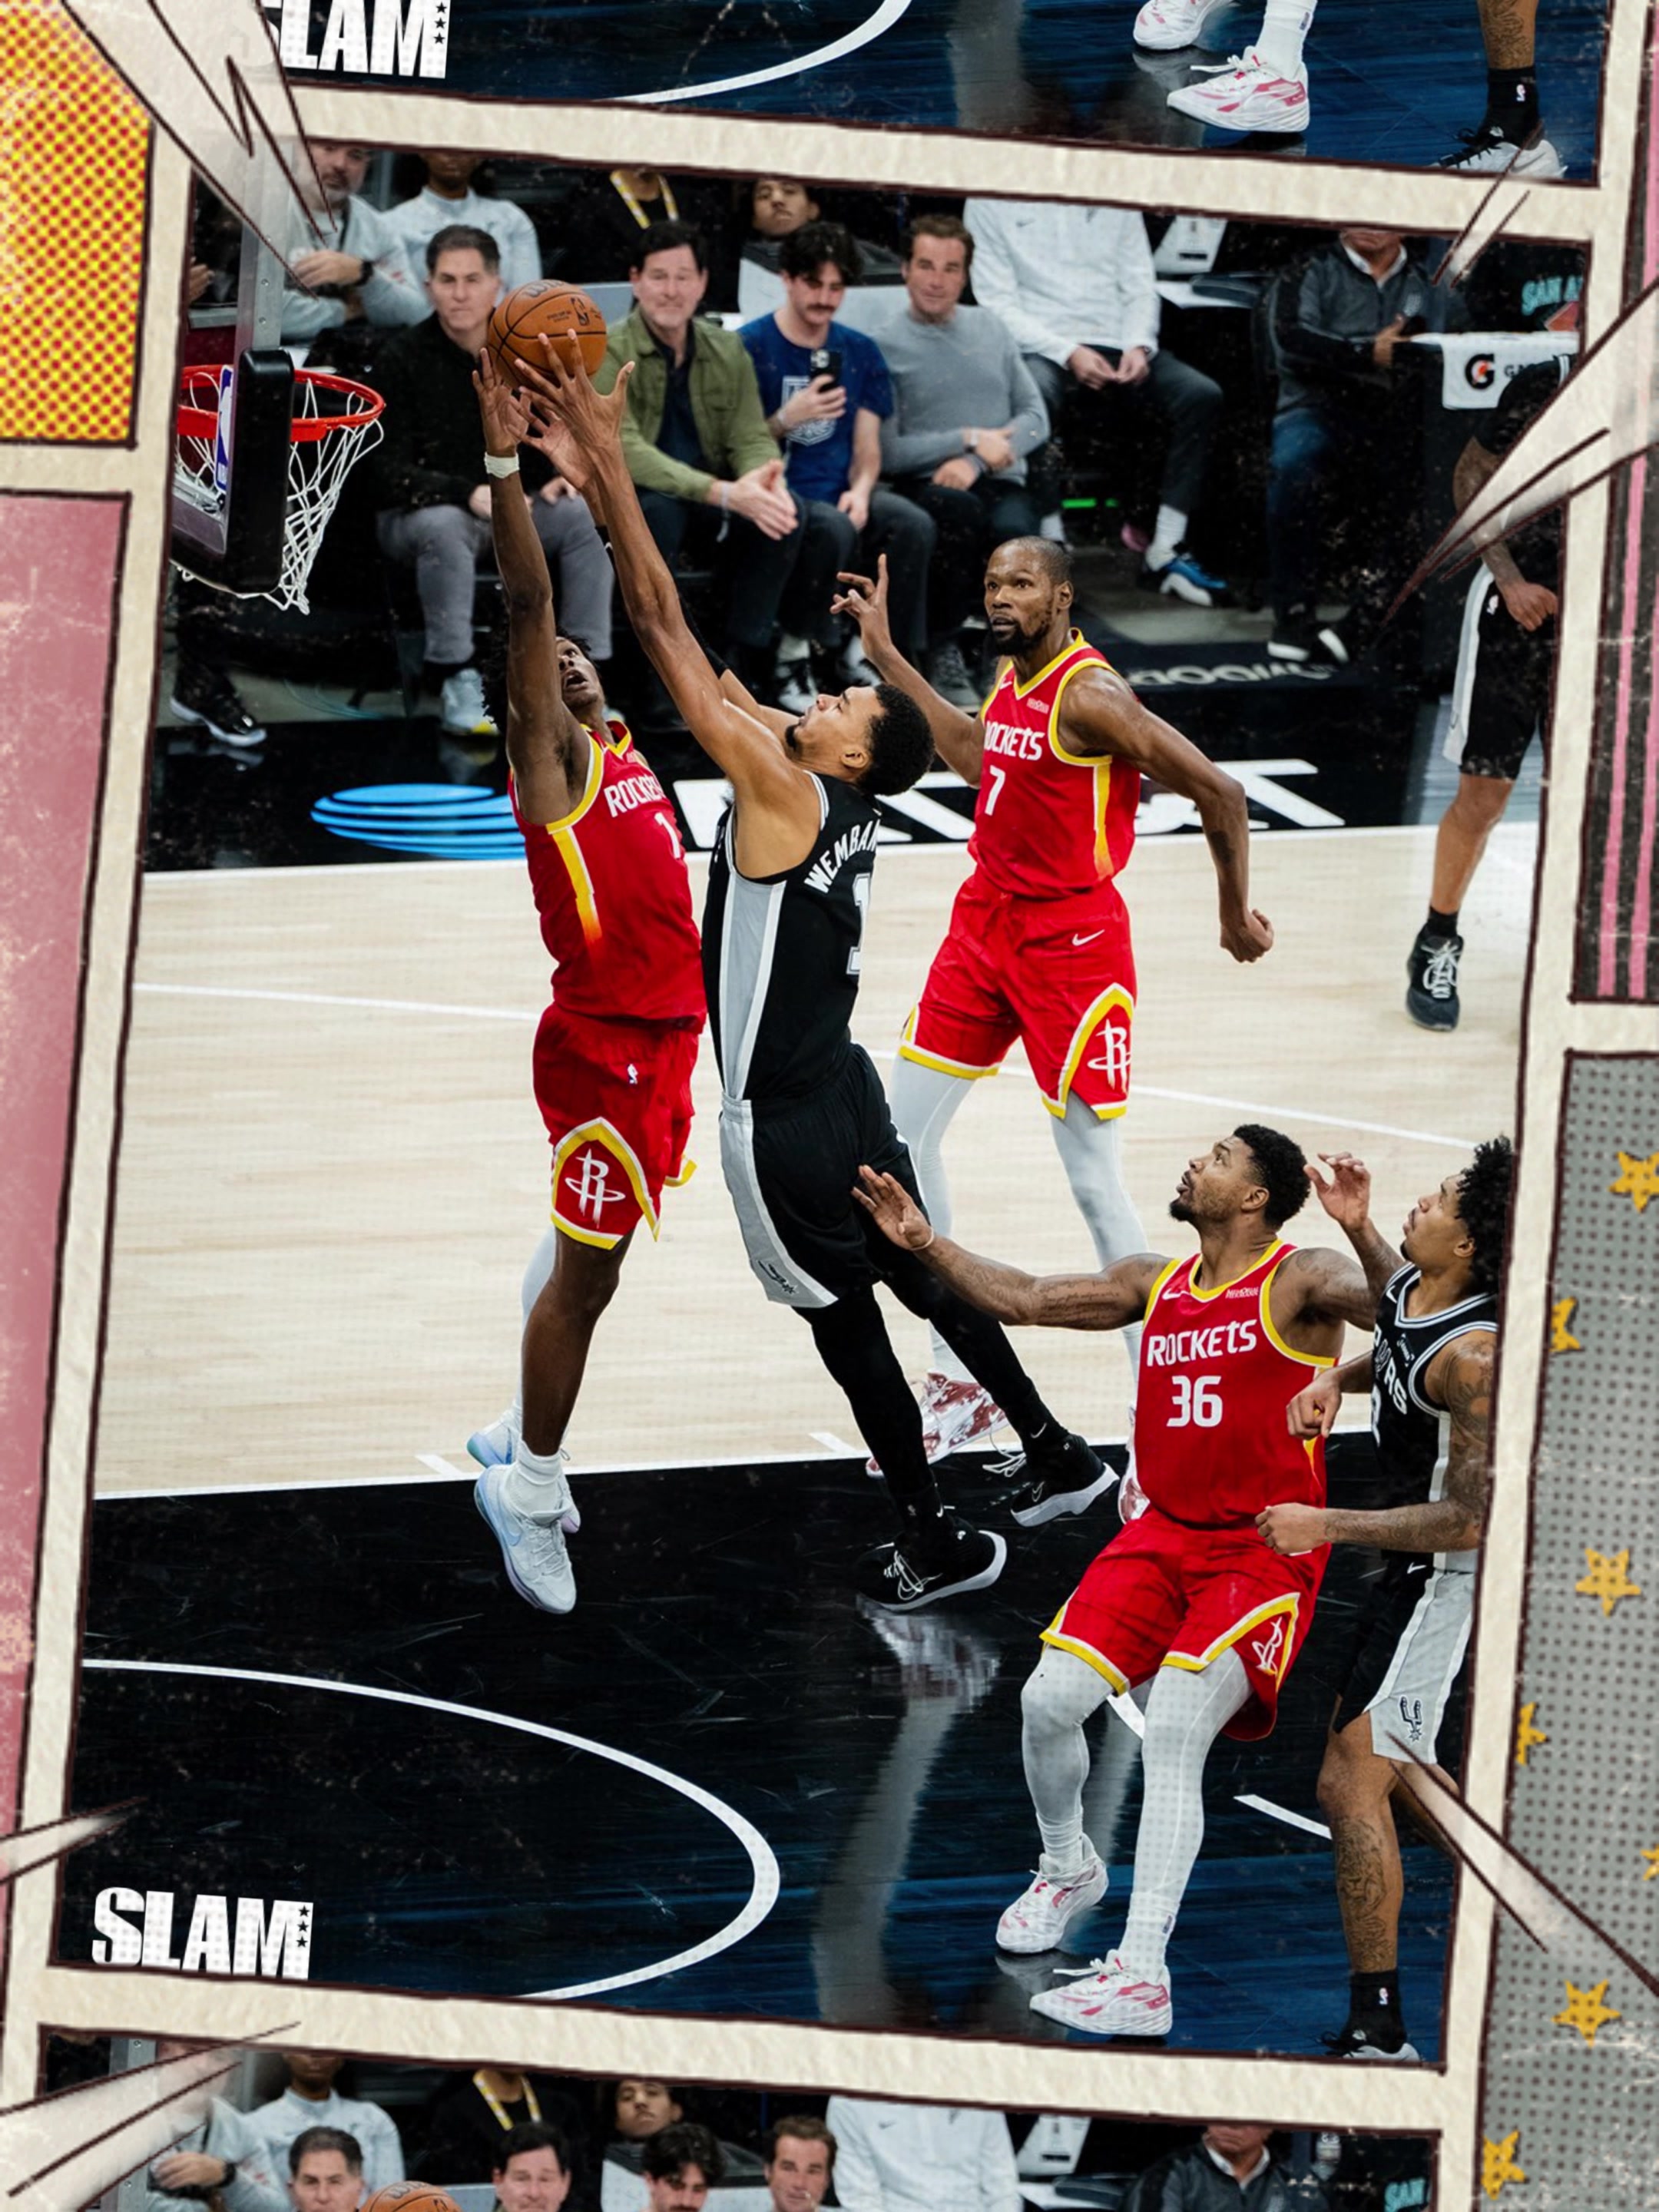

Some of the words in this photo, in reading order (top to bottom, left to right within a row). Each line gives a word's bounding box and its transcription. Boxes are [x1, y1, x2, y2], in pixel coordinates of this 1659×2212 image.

[984, 765, 1006, 816] 7
[654, 812, 680, 859] 1
[1147, 1319, 1257, 1367] ROCKETS
[1166, 1376, 1223, 1428] 36
